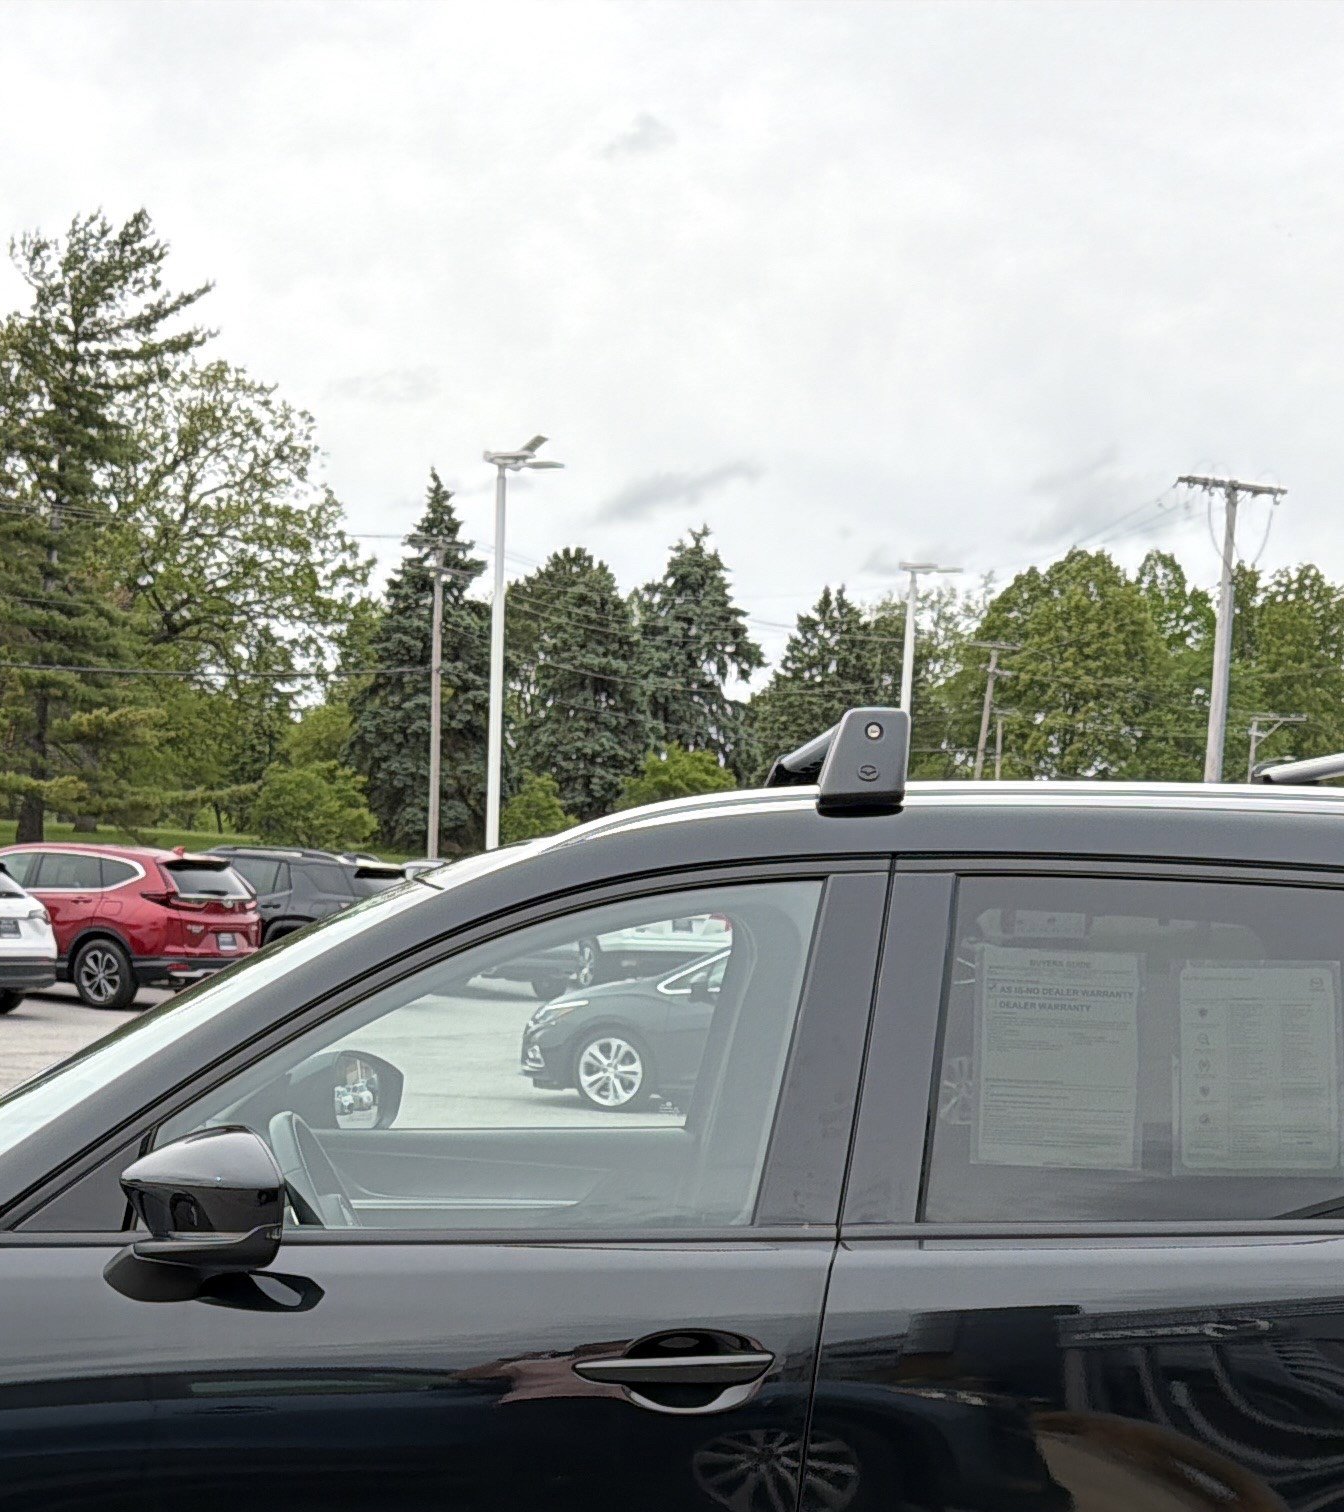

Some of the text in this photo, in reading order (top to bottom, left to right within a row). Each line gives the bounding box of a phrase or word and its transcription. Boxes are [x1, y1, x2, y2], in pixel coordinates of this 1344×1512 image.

[1042, 988, 1080, 997] DEALER
[1081, 989, 1134, 999] WARRANTY
[999, 1001, 1092, 1012] DEALER WARRANTY
